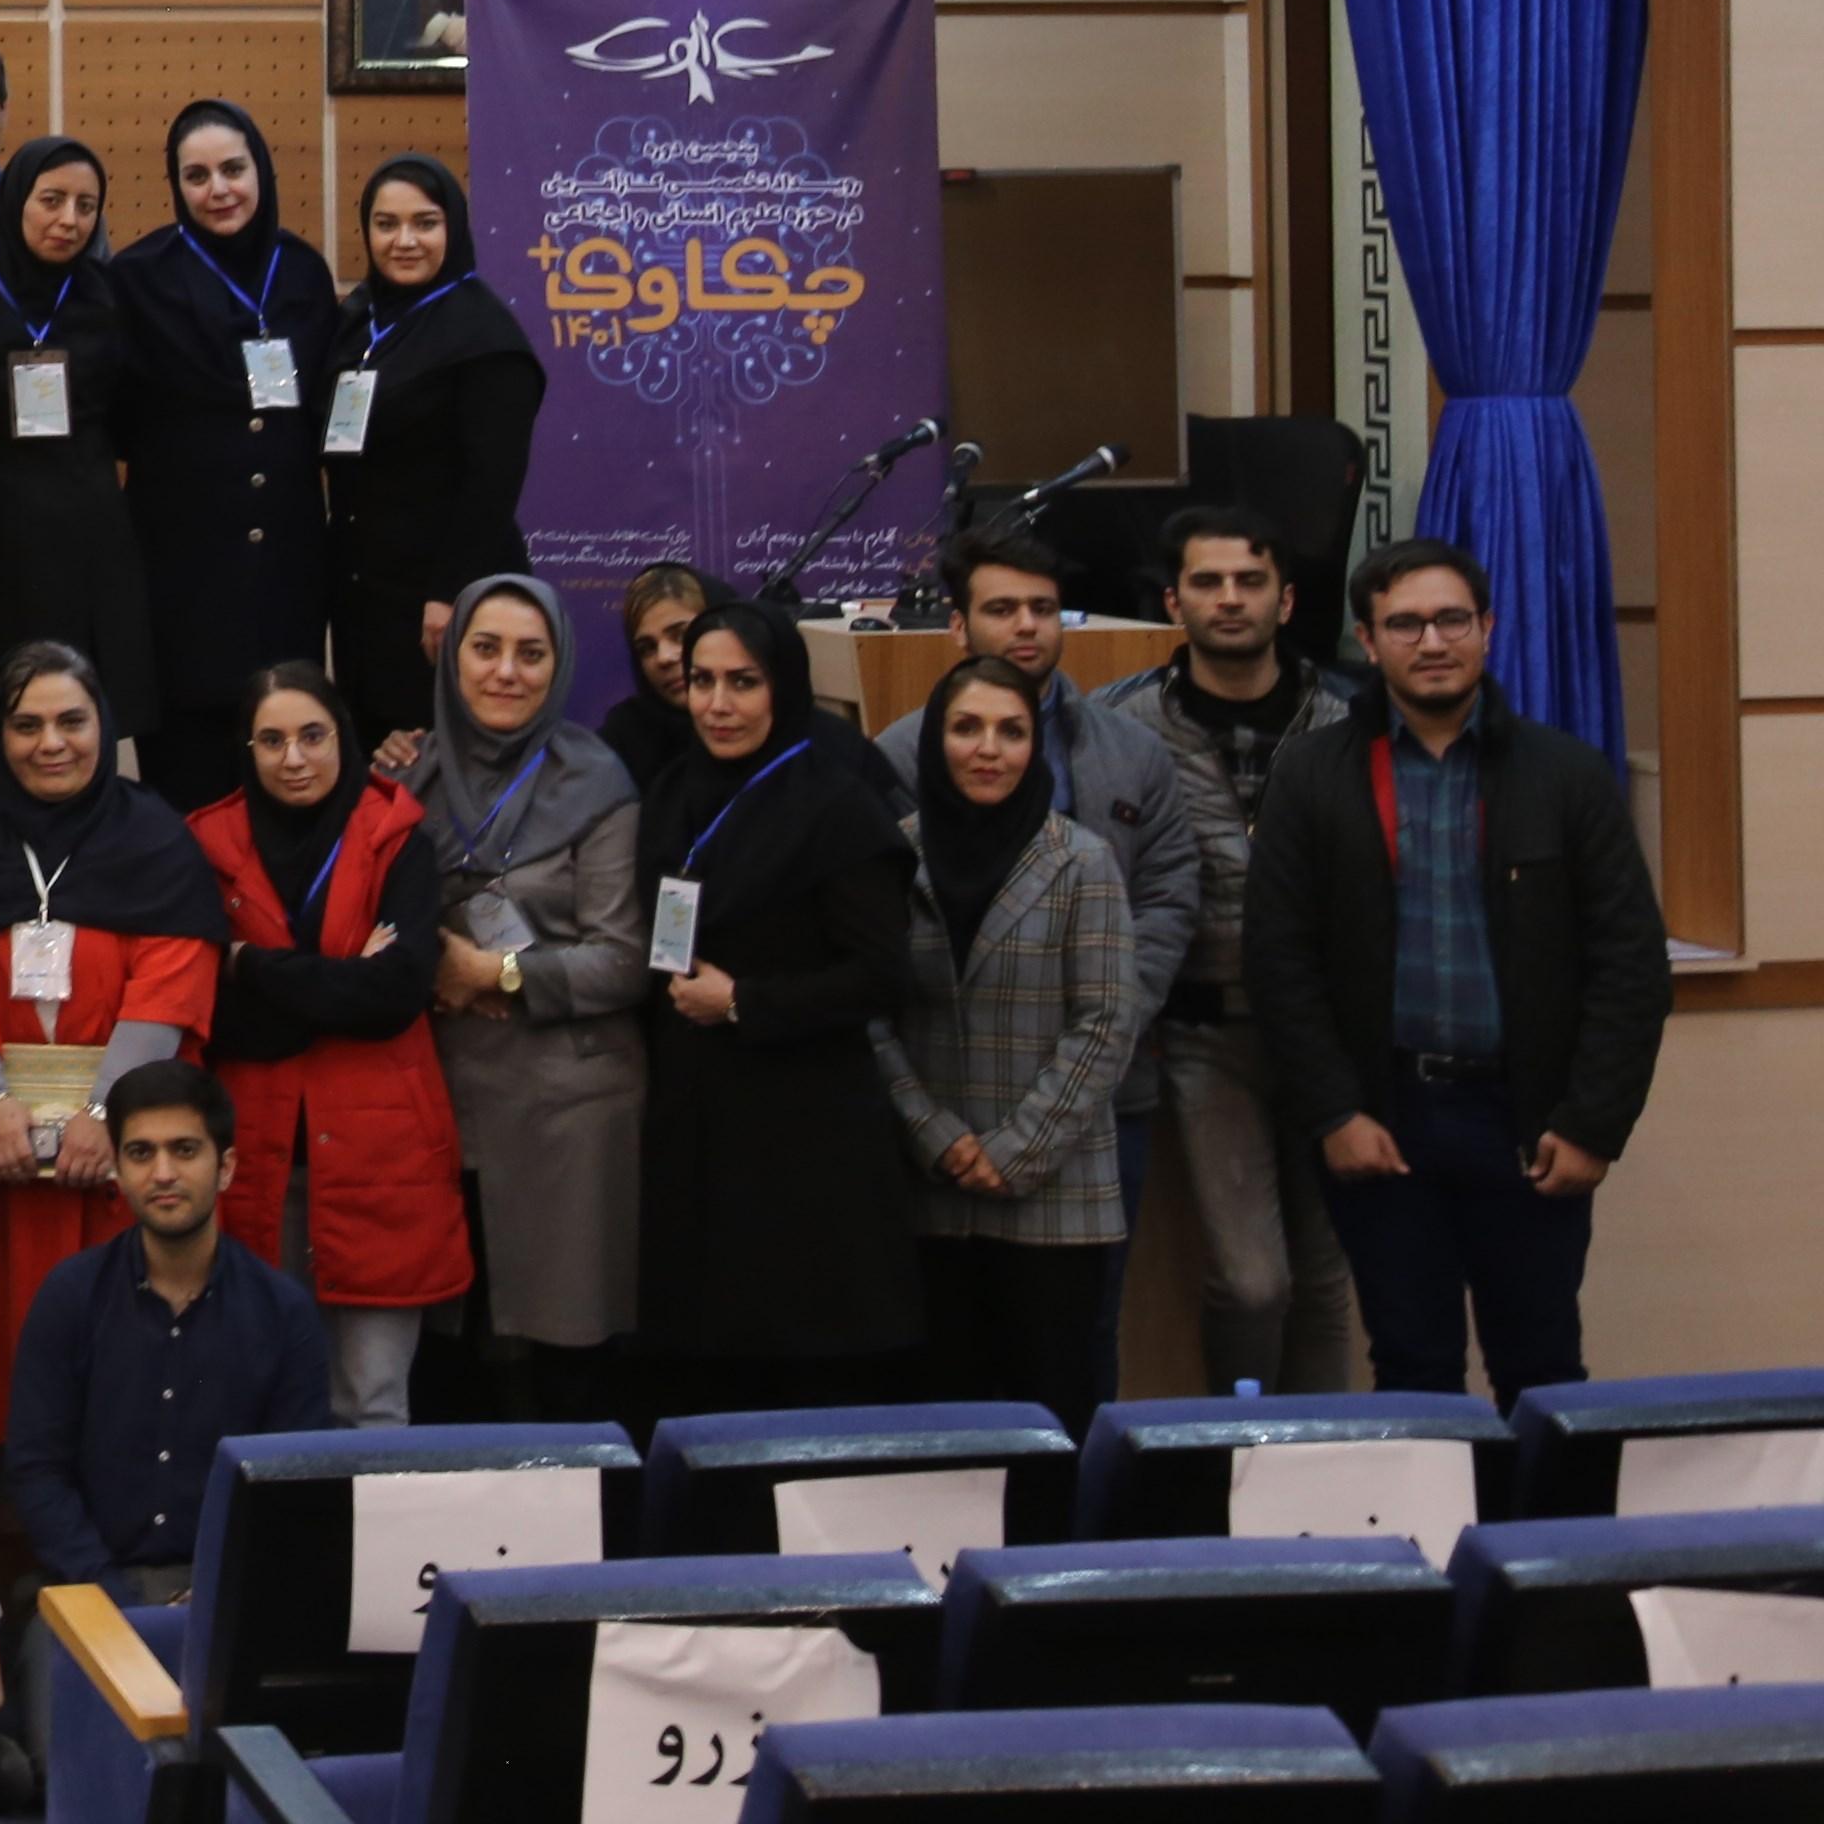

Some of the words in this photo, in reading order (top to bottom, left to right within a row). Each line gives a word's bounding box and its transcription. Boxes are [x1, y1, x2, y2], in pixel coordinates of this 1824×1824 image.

[643, 141, 683, 164] دوره
[685, 138, 759, 165] پنجمین
[663, 170, 769, 198] تخصصی
[770, 172, 863, 197] رویداد
[544, 200, 632, 231] اجتماعی
[633, 208, 649, 231] و
[651, 200, 725, 232] انسانی
[726, 200, 783, 233] علوم
[784, 203, 836, 231] حوزه
[836, 203, 864, 231] در
